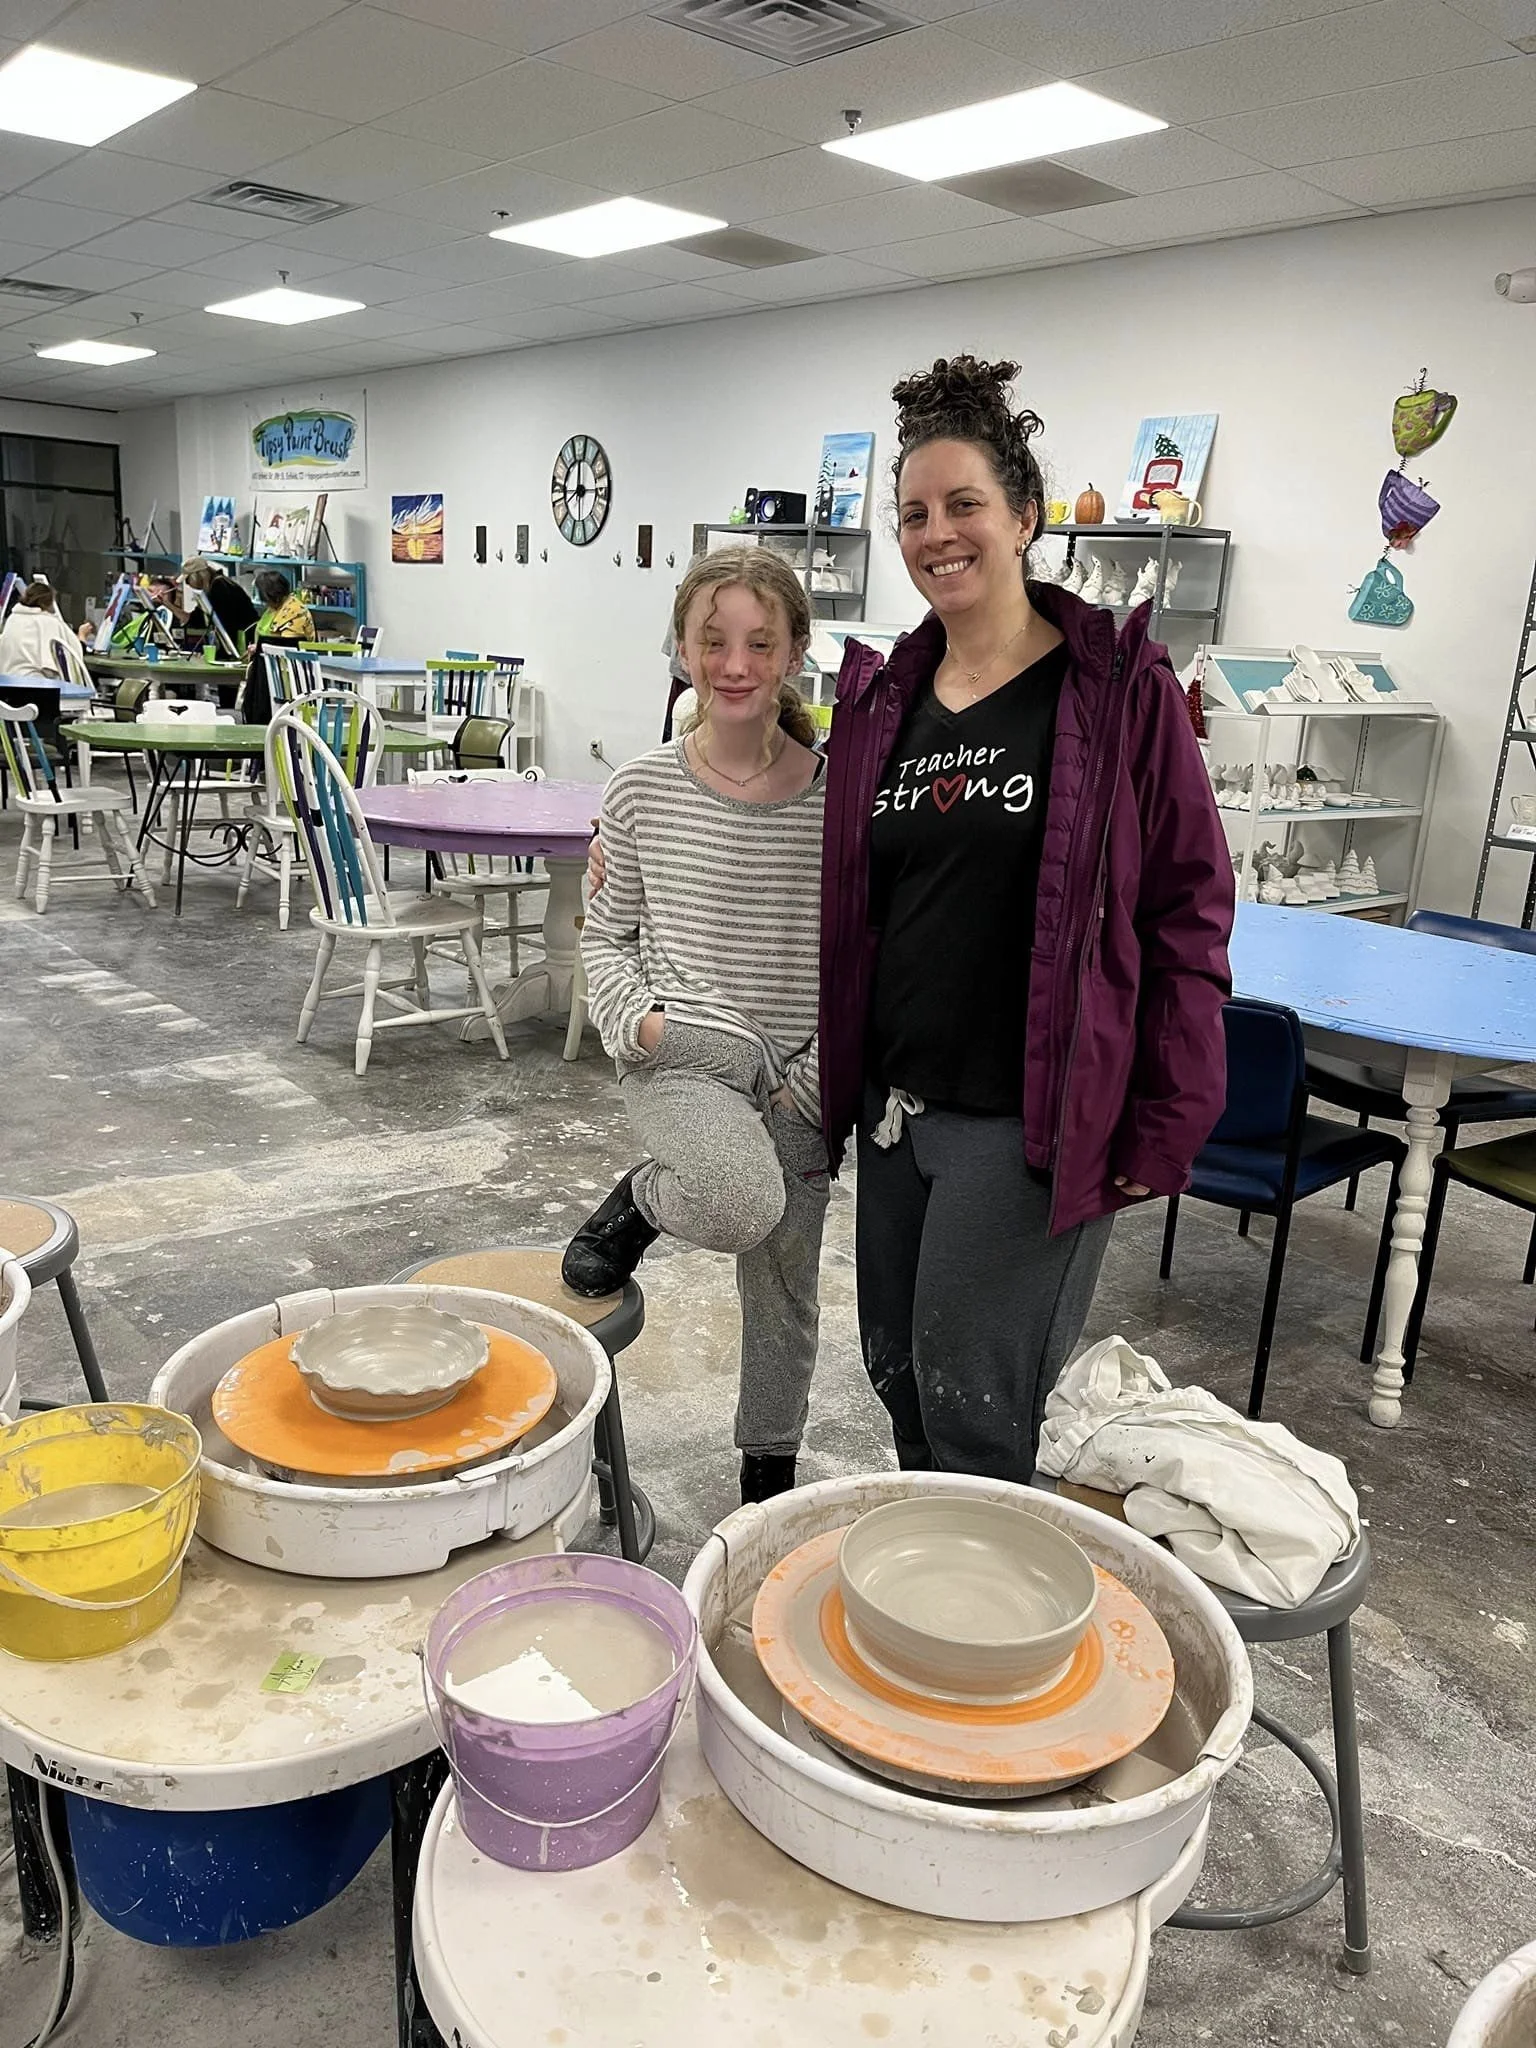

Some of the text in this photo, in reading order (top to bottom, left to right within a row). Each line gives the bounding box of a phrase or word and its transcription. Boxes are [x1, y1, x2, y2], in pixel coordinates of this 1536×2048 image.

[255, 416, 352, 466] Tipsy Paint Brush
[899, 744, 1006, 779] Teacher
